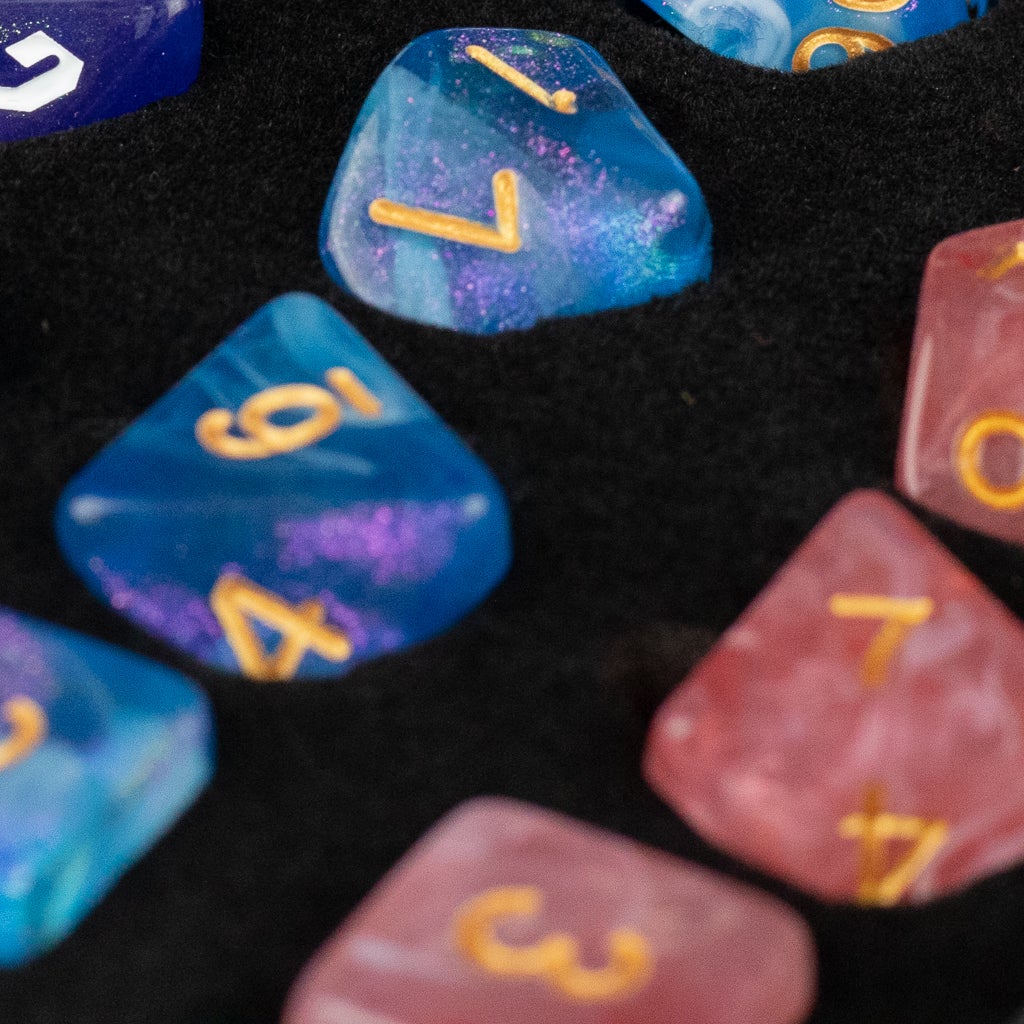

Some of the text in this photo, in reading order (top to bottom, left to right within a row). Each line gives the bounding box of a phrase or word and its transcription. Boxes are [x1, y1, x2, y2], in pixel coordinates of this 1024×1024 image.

[466, 44, 577, 114] 1
[368, 168, 522, 254] 7
[210, 572, 352, 682] 4
[828, 591, 935, 691] 7
[835, 781, 950, 907] 4
[453, 885, 653, 1003] 3
